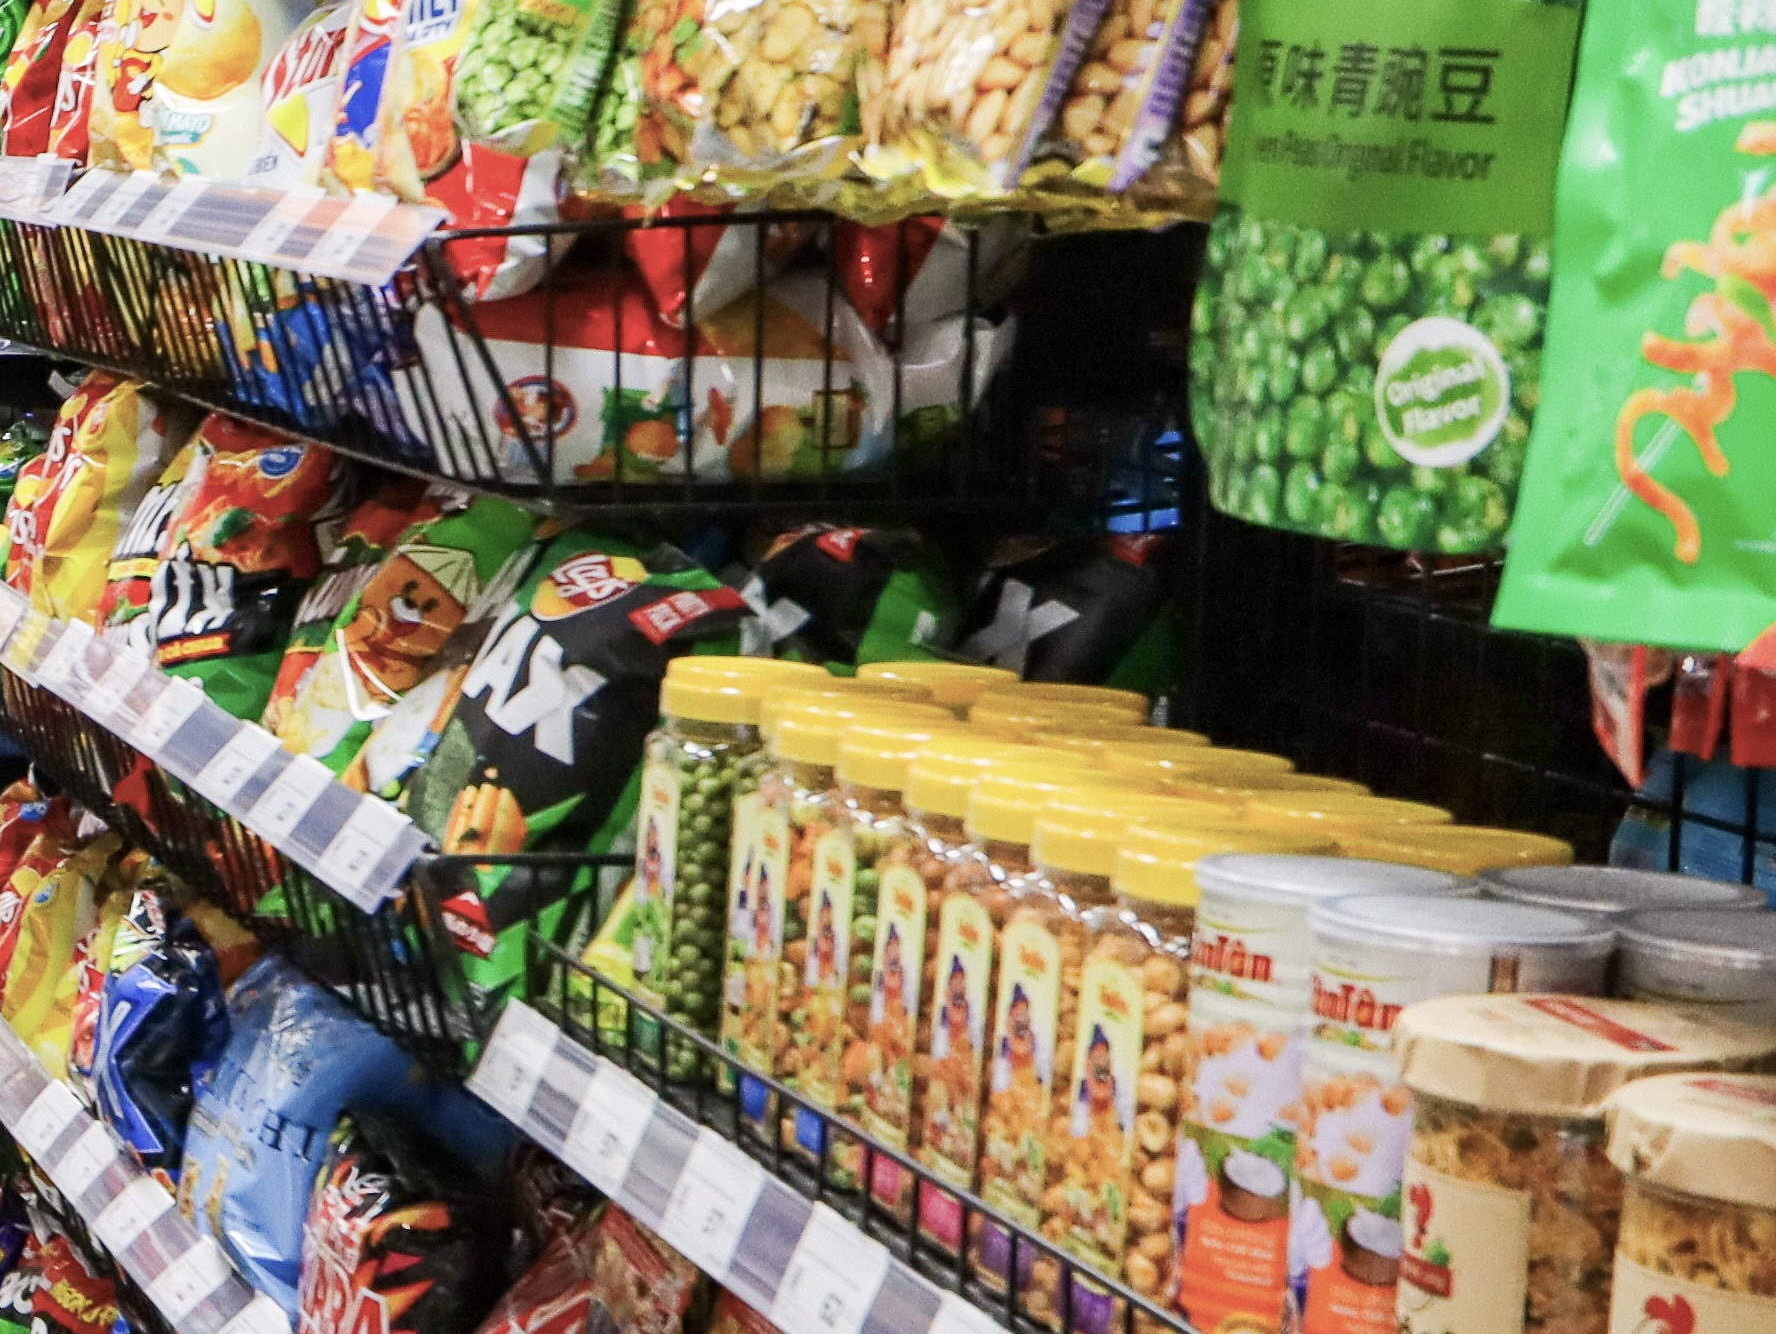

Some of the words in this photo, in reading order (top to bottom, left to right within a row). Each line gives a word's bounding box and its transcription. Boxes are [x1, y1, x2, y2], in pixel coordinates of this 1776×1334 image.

[1408, 141, 1497, 180] Flavor
[1387, 360, 1487, 408] Original
[1403, 394, 1483, 438] Flavor
